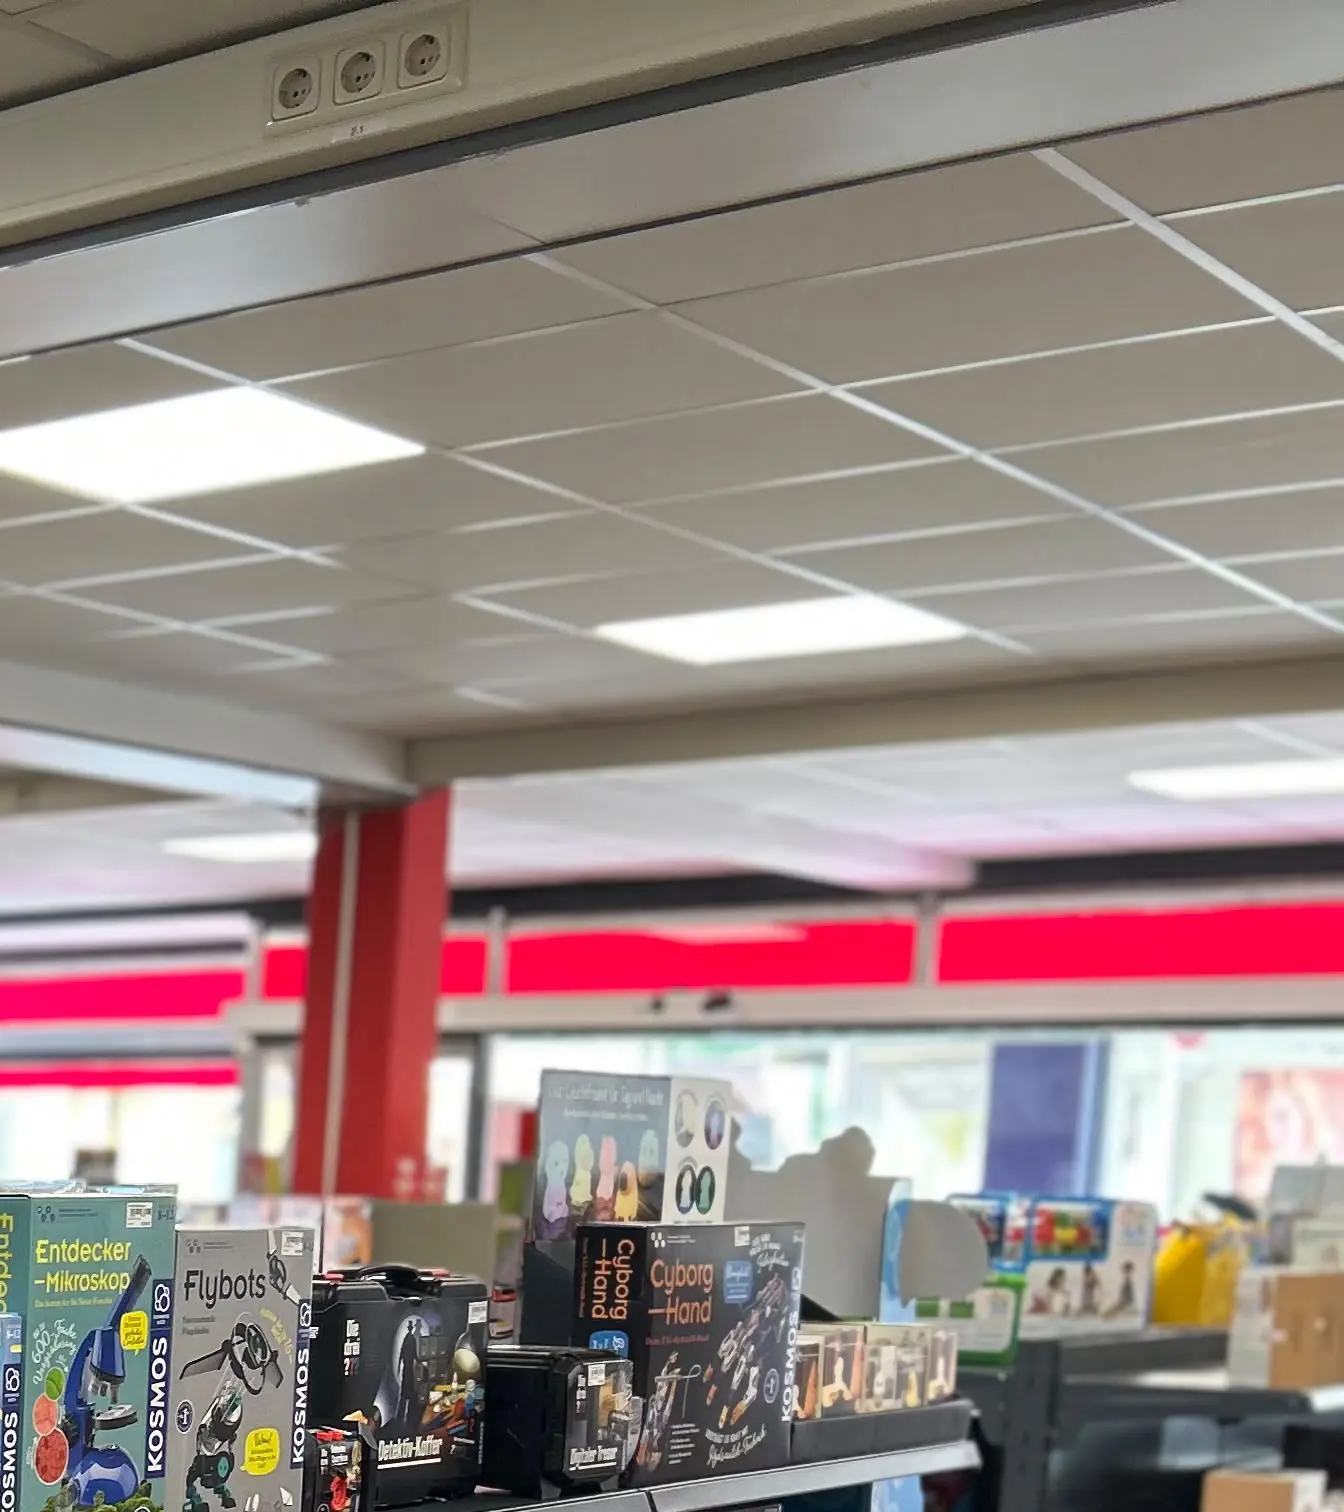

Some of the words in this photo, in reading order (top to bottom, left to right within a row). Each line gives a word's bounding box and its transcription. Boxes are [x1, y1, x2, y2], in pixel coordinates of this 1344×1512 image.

[36, 1237, 130, 1263] Entdecker
[185, 1267, 266, 1307] Flybots
[650, 1260, 713, 1294] Cyborg
[147, 1337, 166, 1473] KOSMOS
[293, 1348, 309, 1463] KOSMOS
